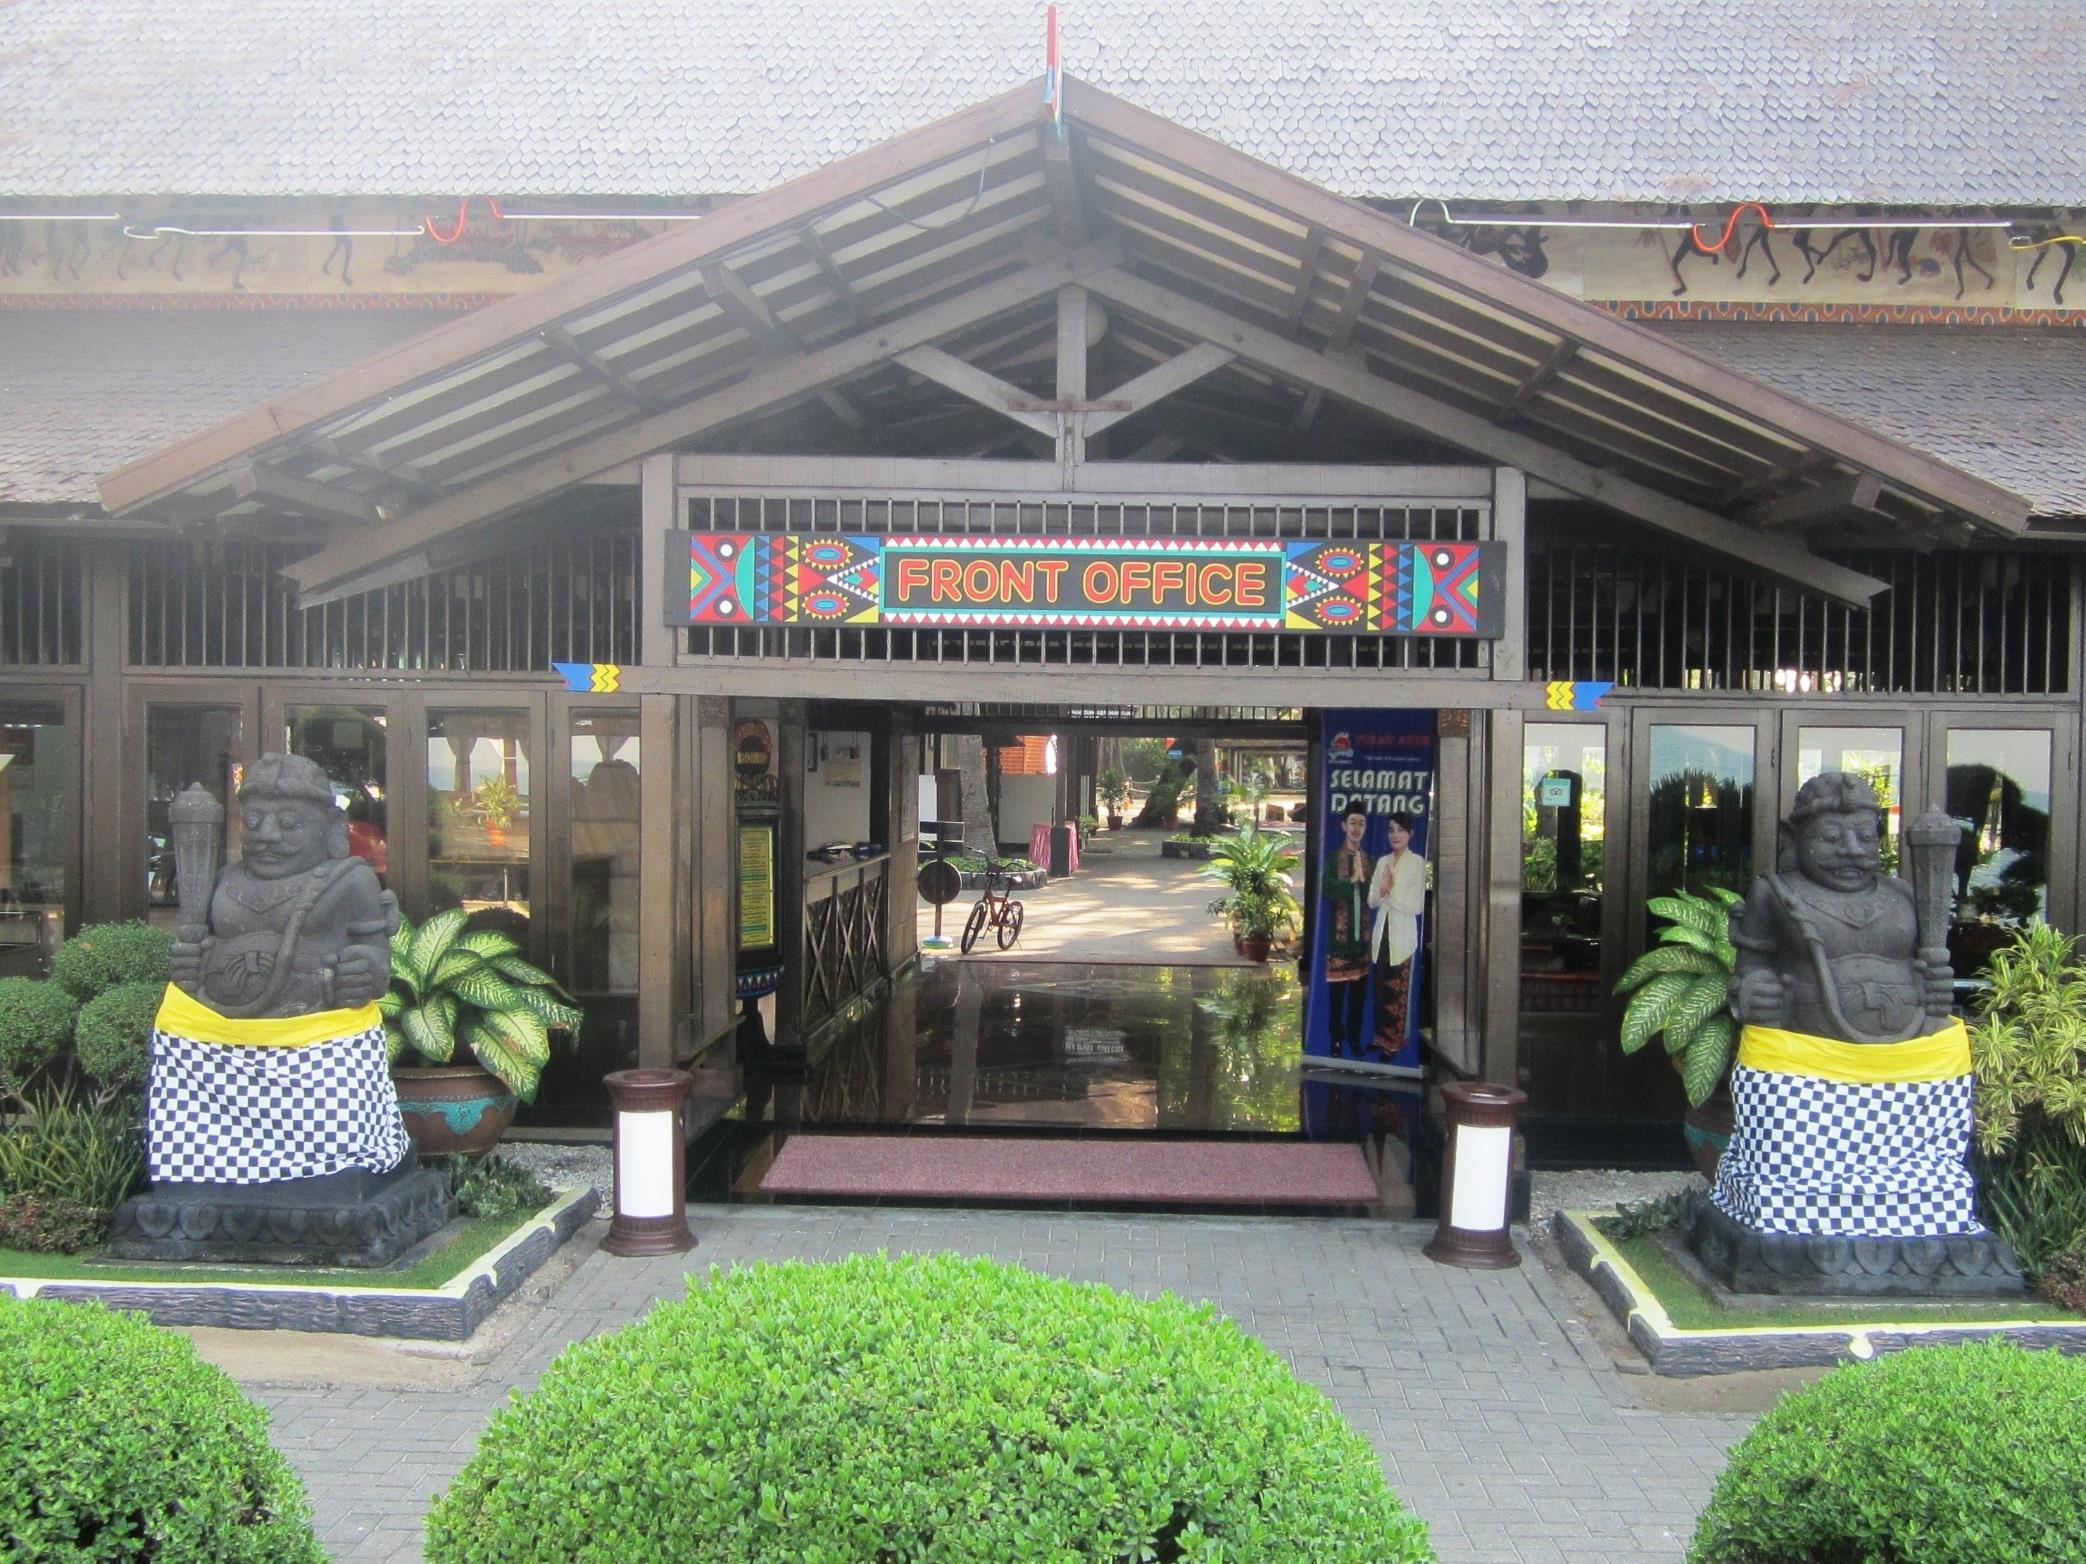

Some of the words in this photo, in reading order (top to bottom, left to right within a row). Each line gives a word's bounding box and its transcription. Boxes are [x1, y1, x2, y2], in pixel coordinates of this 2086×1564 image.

[899, 559, 1068, 603] FRONT
[1083, 561, 1265, 606] OFFICE
[1330, 769, 1429, 790] SELAMAT
